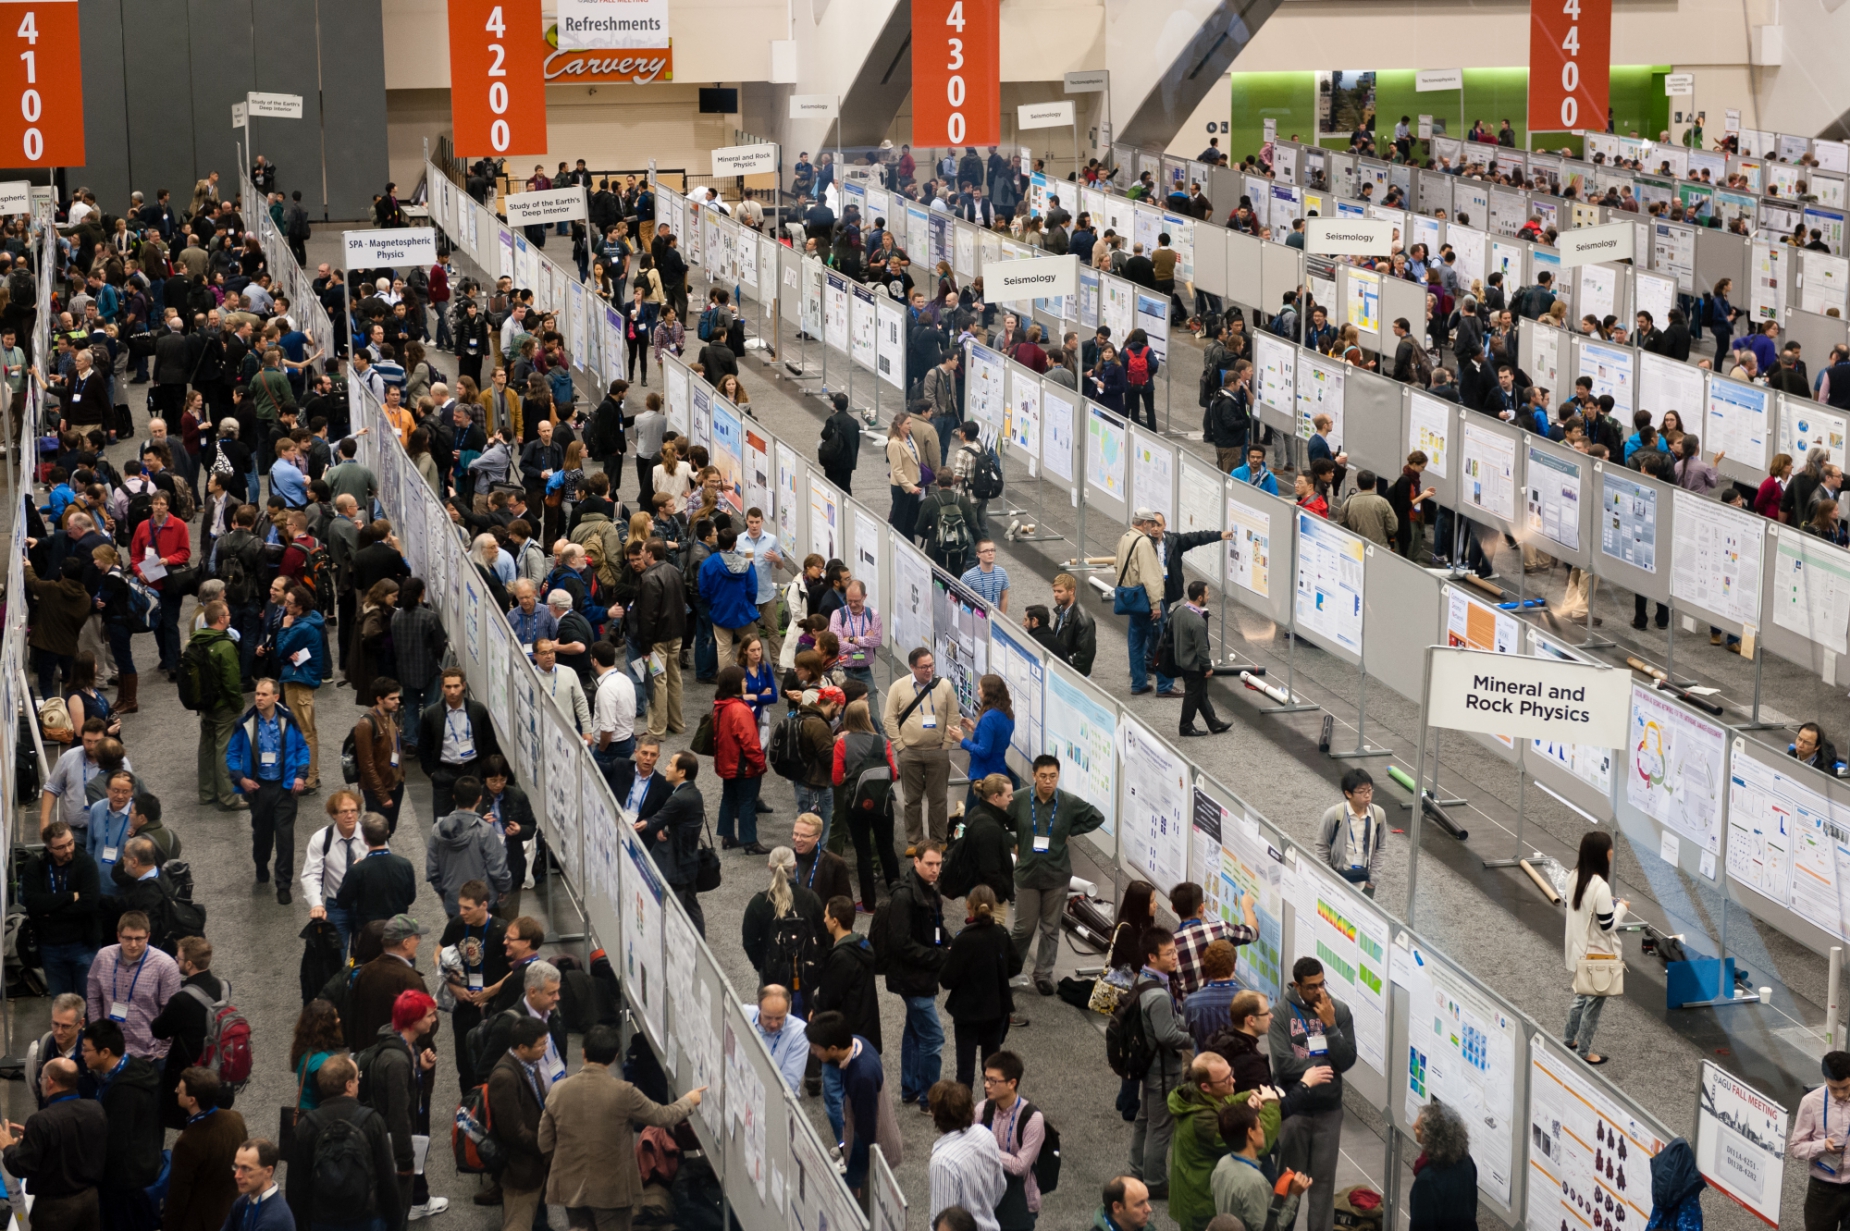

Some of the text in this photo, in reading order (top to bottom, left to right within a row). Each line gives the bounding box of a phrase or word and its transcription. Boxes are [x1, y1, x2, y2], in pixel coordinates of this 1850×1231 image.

[566, 16, 660, 31] Refreshments
[544, 49, 666, 85] Carvery
[946, 1, 966, 144] 4300
[1561, 0, 1580, 127] 4400
[18, 12, 43, 160] 4100
[486, 6, 510, 152] 4200
[718, 153, 740, 163] Mineral
[544, 206, 569, 214] Interior
[349, 240, 363, 249] SPA
[369, 236, 431, 249] Magnetospheric
[1326, 232, 1374, 242] Seismology
[1576, 240, 1617, 251] Seismology
[377, 250, 404, 260] Physics
[1004, 274, 1056, 285] Seismology
[1473, 674, 1585, 702] Mineral and
[1466, 694, 1590, 723] Rock Physics
[1718, 1077, 1778, 1120] AGU FALL MEETING
